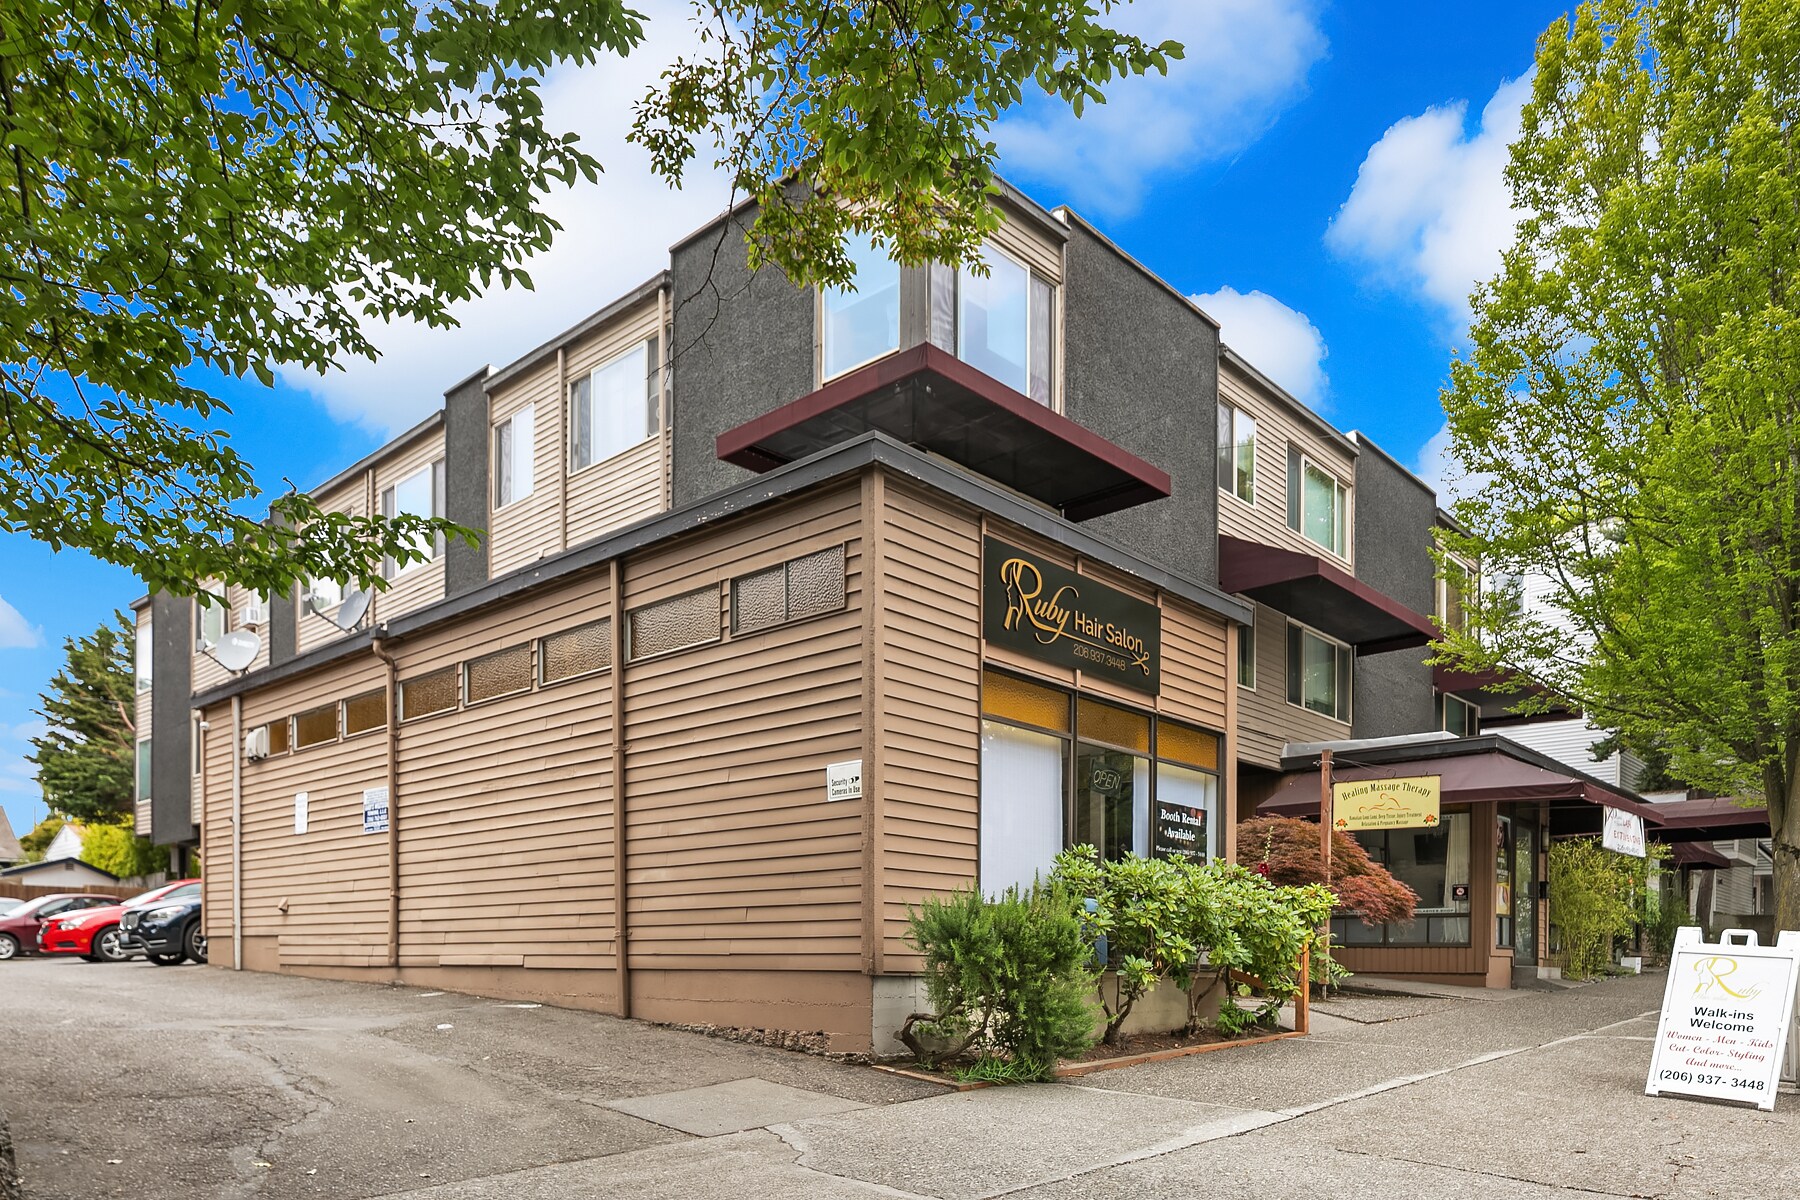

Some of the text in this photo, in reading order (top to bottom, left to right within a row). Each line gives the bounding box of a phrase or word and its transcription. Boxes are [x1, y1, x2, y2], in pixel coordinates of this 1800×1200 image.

[1001, 558, 1144, 654] Ruby Hair Salon
[1073, 643, 1126, 671] 206.937.3448
[831, 778, 848, 787] Security
[1093, 769, 1121, 789] OPEN
[831, 788, 848, 796] Cameras
[1341, 782, 1432, 801] Healing Massage Therapy
[1160, 808, 1202, 826] Booth Rental
[1166, 826, 1196, 842] Available
[1693, 956, 1763, 1001] Ruby
[1694, 1006, 1754, 1020] Walk-ins
[1690, 1017, 1755, 1033] Welcome
[1666, 1030, 1702, 1042] Women
[1713, 1035, 1736, 1045] Men
[1747, 1038, 1774, 1048] Kids
[1685, 1057, 1708, 1067] And
[1727, 1048, 1766, 1062] Styling
[1660, 1069, 1693, 1084] (206)
[1730, 1078, 1765, 1091] 3448
